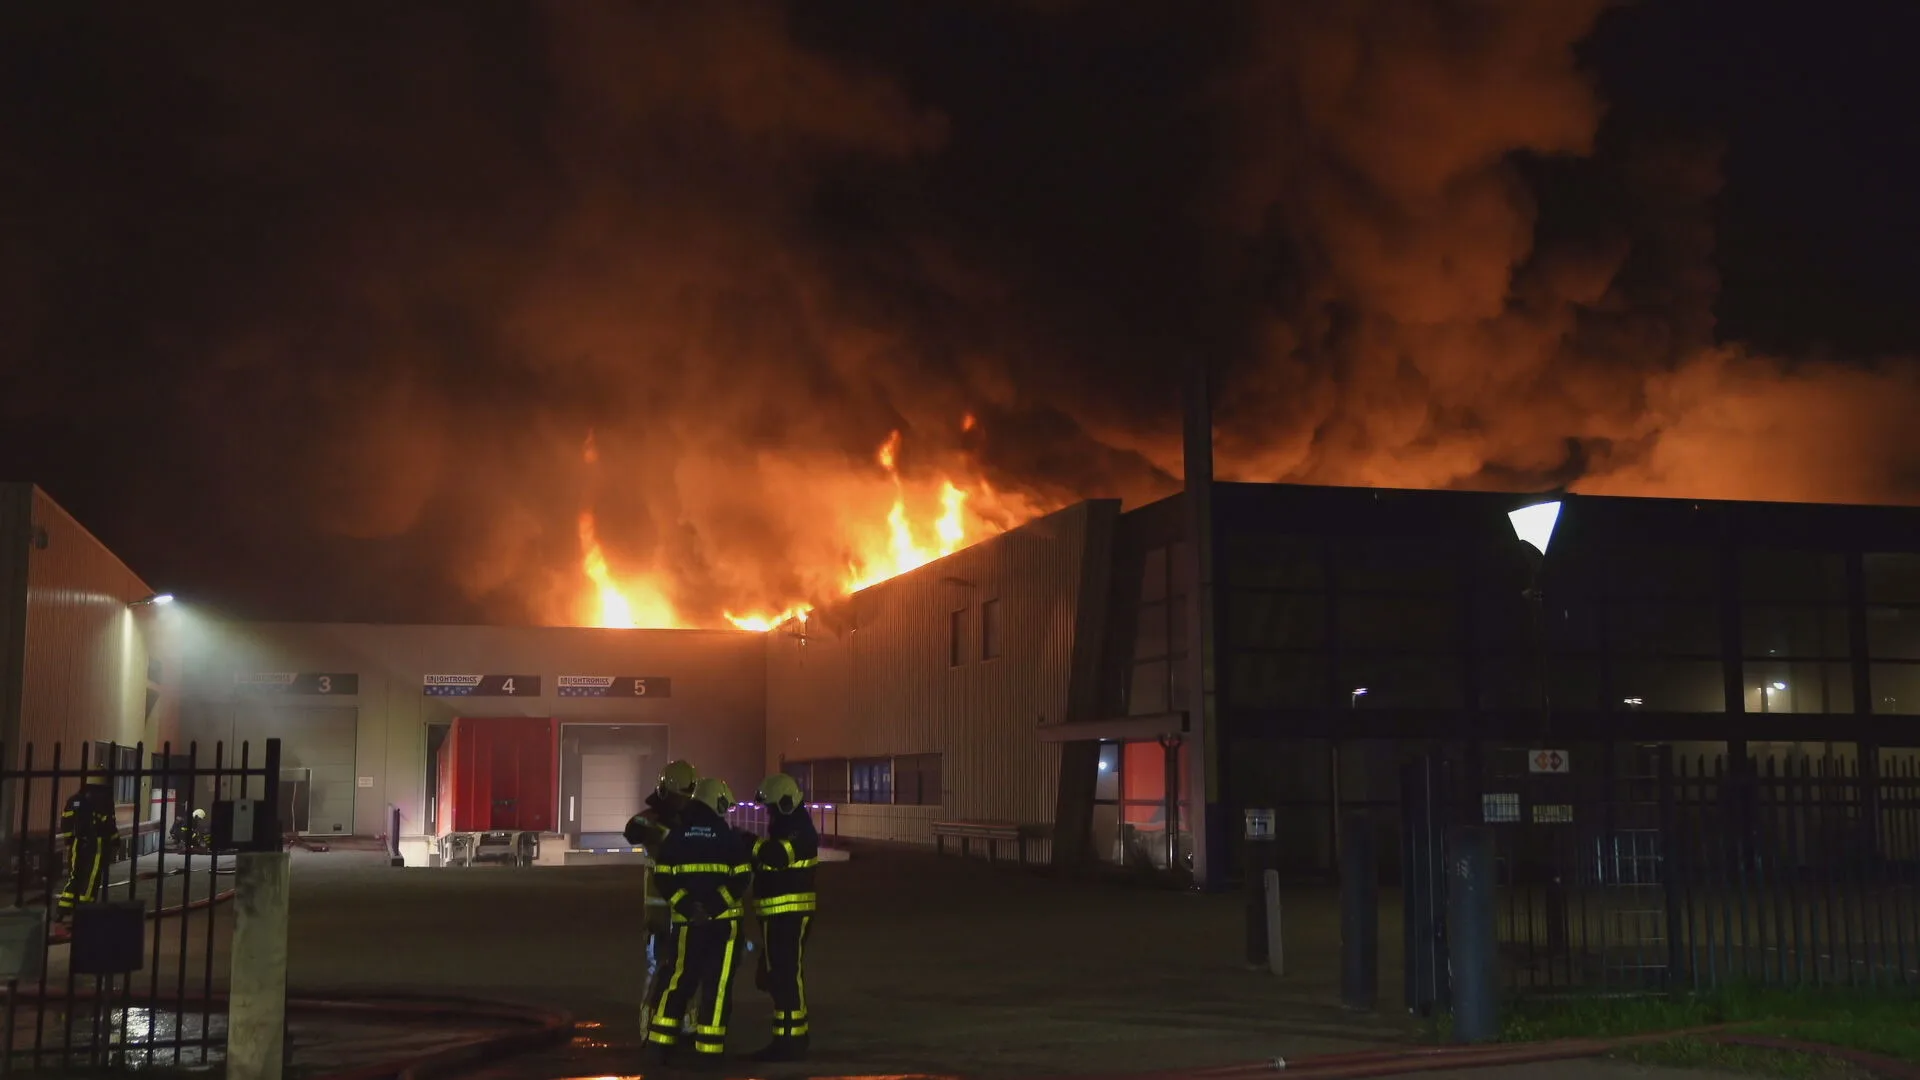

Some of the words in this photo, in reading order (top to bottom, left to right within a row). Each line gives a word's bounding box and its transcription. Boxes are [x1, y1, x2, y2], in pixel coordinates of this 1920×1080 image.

[318, 675, 331, 693] 3
[502, 678, 515, 694] 4
[634, 679, 647, 696] 5
